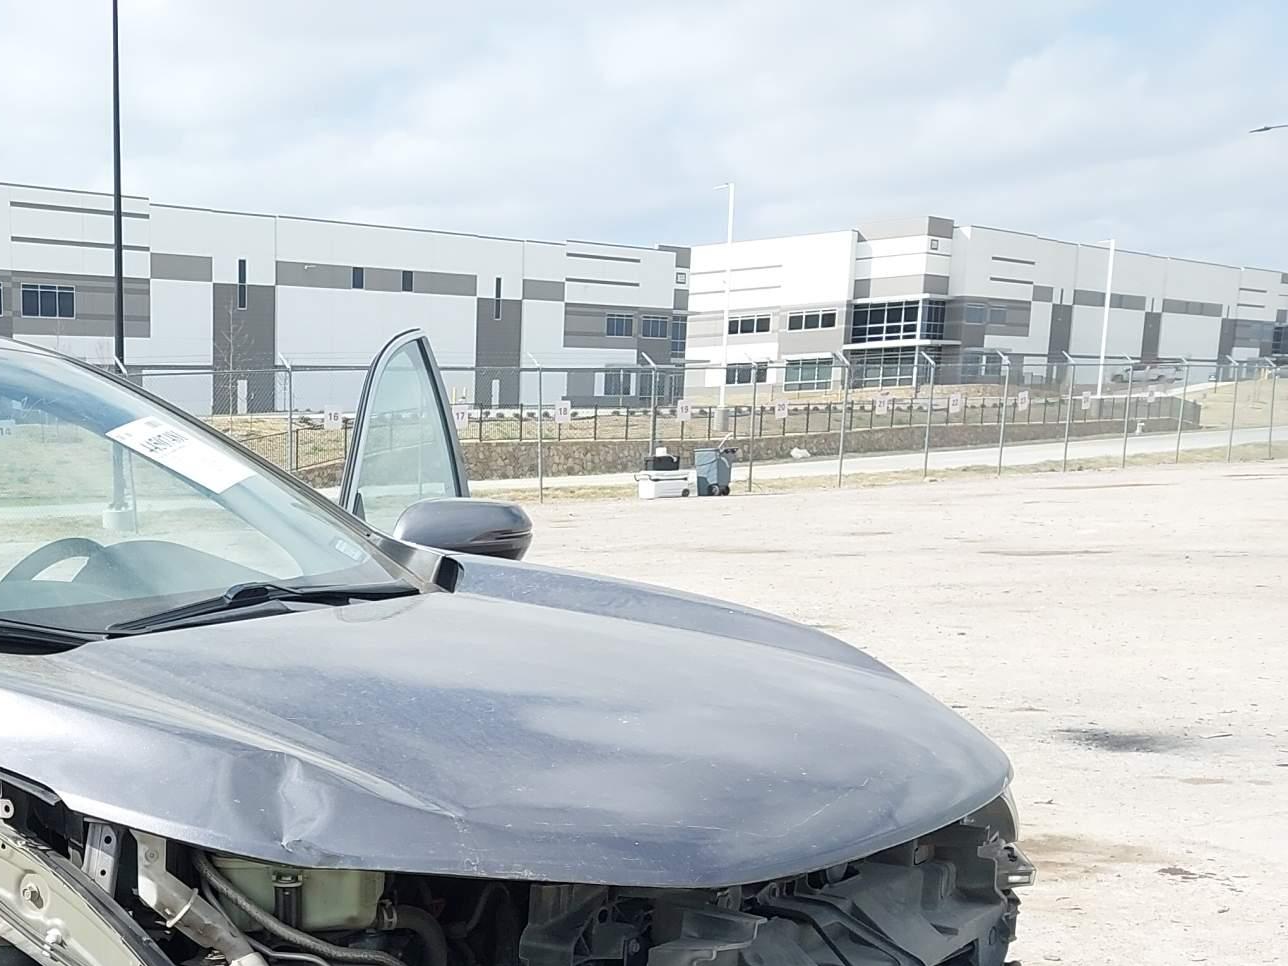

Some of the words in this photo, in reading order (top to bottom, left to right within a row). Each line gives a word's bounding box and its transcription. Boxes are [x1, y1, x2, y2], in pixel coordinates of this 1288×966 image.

[680, 405, 689, 413] 19
[777, 403, 786, 411] 20
[559, 407, 568, 416] 18
[328, 412, 339, 421] 16
[455, 412, 465, 420] 17
